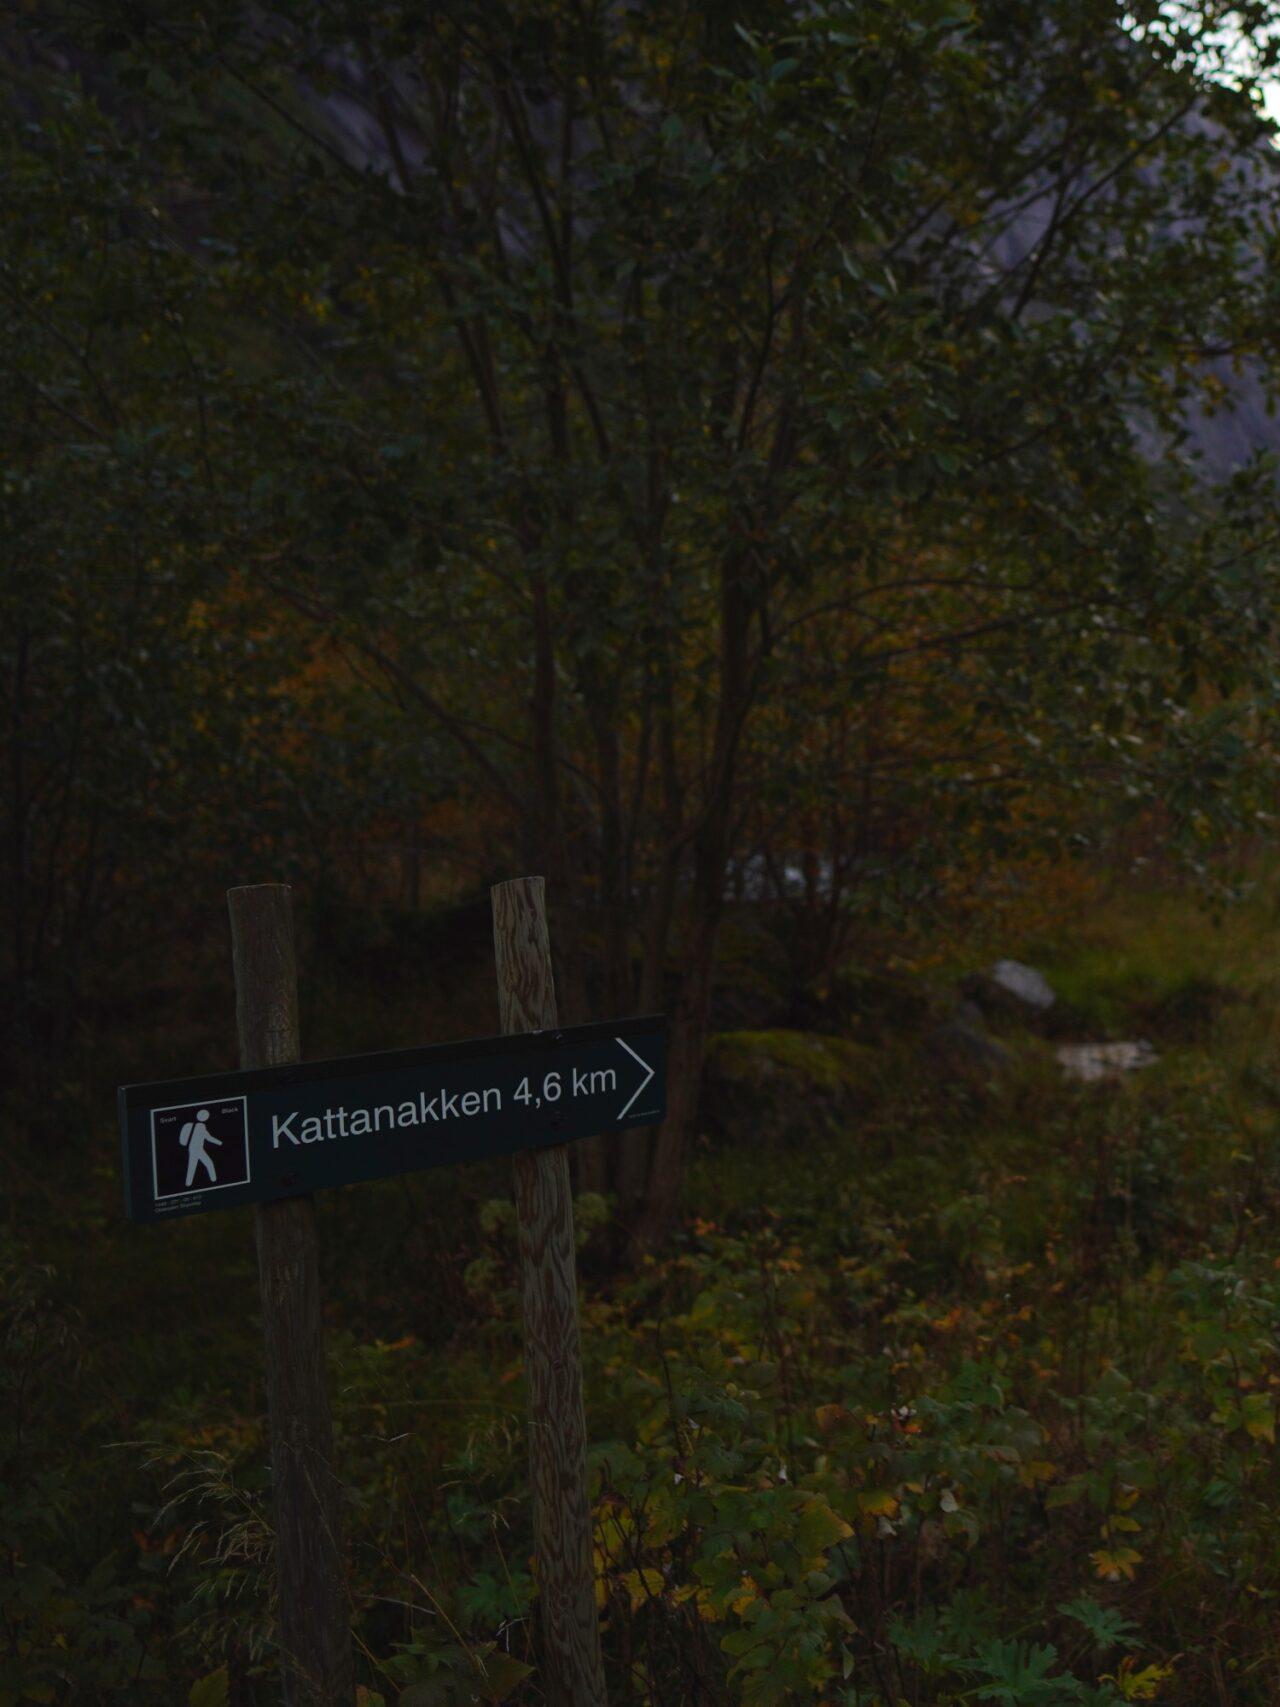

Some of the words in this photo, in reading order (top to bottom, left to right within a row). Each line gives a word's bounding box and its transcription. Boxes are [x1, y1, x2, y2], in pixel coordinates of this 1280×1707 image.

[272, 1088, 502, 1148] Kattanakken
[513, 1072, 561, 1109] 4,6
[572, 1068, 617, 1097] km
